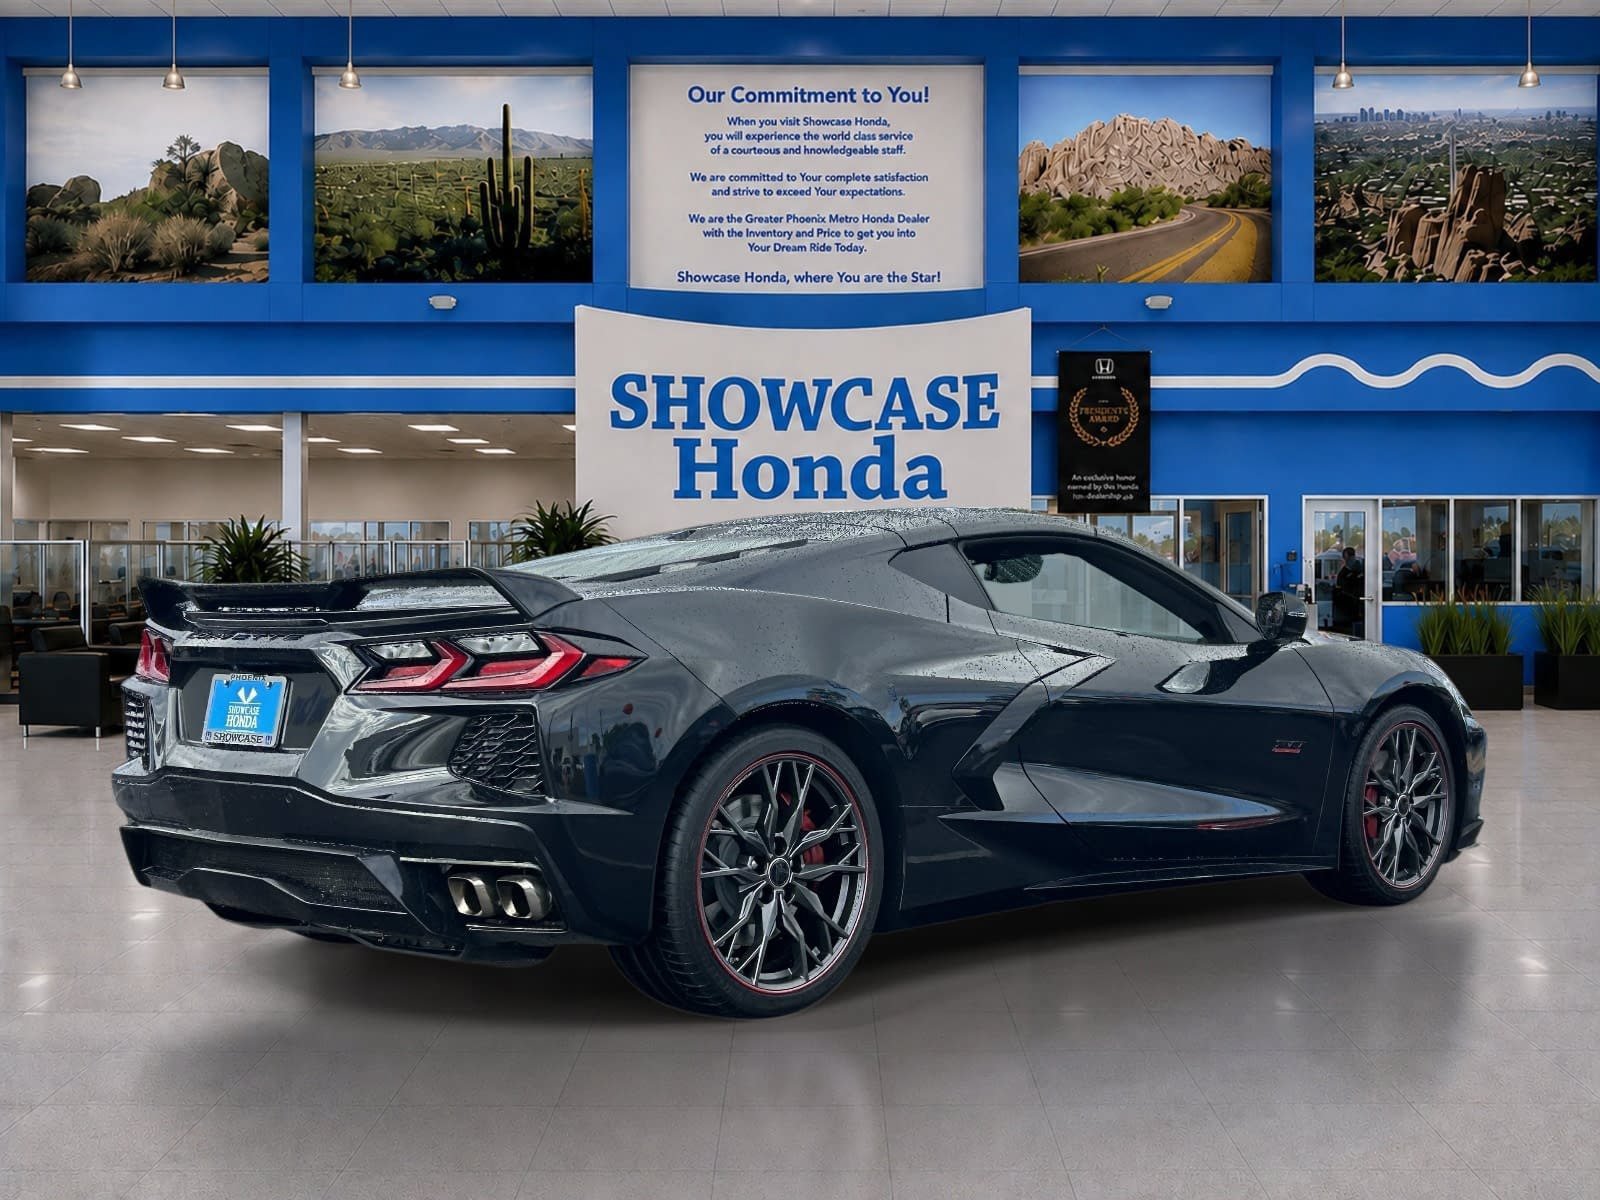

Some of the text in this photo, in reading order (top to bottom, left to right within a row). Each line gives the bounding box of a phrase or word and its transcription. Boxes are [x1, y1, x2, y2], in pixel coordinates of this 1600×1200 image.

[688, 85, 930, 104] Our Commitment to You!
[726, 116, 890, 128] When you visit Showcase Honda,
[704, 130, 914, 144] you will experience the world class service
[710, 144, 720, 154] of
[730, 146, 780, 156] courteous
[782, 144, 802, 154] and
[882, 144, 906, 154] staff.
[690, 172, 708, 182] We
[728, 171, 784, 182] committed
[786, 173, 798, 182] to
[800, 172, 822, 182] Your
[824, 172, 872, 184] complete
[874, 171, 928, 182] satisfaction
[712, 185, 906, 200] and strive to exceed Your expectations.
[688, 213, 930, 224] We are the Greater Phoenix Metro Honda Dealer
[702, 227, 916, 240] with the Inventory and Price to get you into
[748, 242, 868, 254] Your Dream Ride Today.
[678, 270, 940, 286] Showcase Honda, where You are the Star!
[610, 373, 1000, 431] SHOWCASE
[673, 434, 947, 500] Honda
[228, 705, 260, 716] SHOWCASE
[226, 714, 258, 728] HONDA
[213, 732, 264, 744] SHOWCASE
